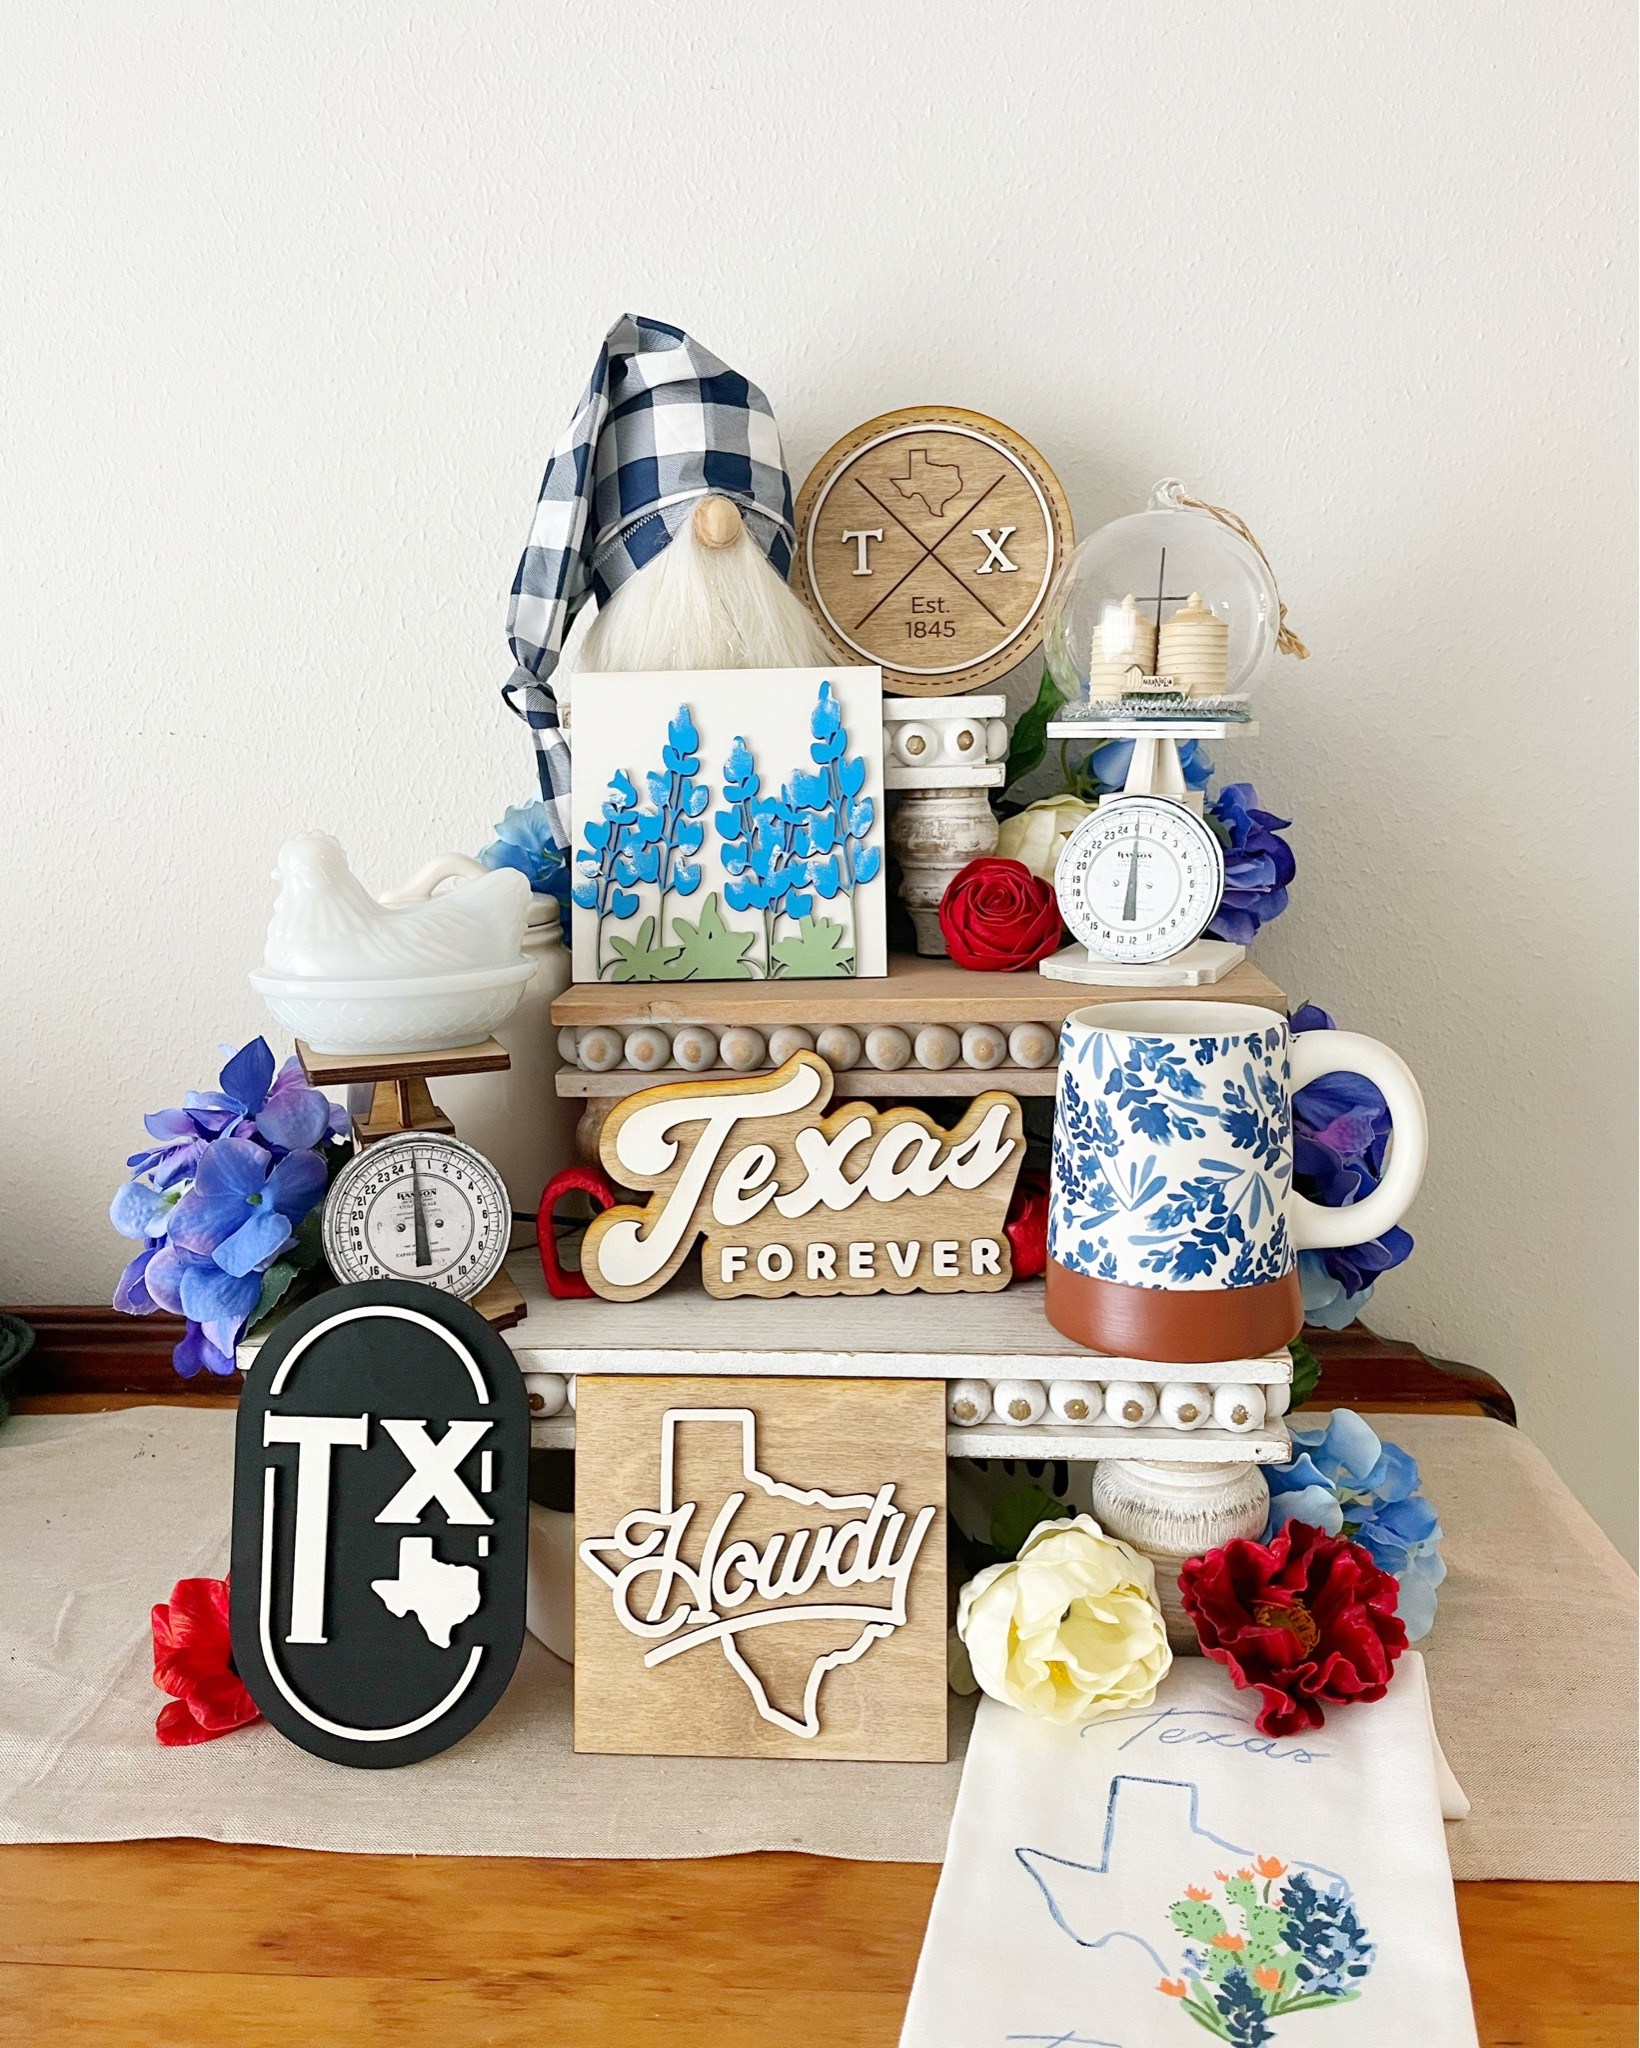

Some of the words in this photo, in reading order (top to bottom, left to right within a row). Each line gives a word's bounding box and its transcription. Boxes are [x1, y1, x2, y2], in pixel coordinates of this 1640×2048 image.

[841, 528, 883, 576] T
[972, 526, 1018, 574] X
[911, 596, 950, 614] Est.
[905, 621, 956, 639] 1845
[1118, 826, 1128, 834] 24
[1104, 831, 1115, 840] 23
[1162, 831, 1167, 840] 2
[1092, 840, 1102, 849] 22
[1173, 840, 1178, 848] 3
[1083, 850, 1091, 858] 21
[1181, 851, 1186, 859] 4
[1076, 862, 1087, 870] 20
[1187, 865, 1192, 874] 5
[1189, 880, 1194, 888] 6
[1076, 901, 1084, 910] 17
[1180, 908, 1185, 916] 8
[1083, 913, 1090, 921] 16
[1090, 922, 1098, 930] 15
[1171, 919, 1175, 927] 9
[1103, 930, 1110, 938] 14
[1158, 927, 1165, 935] 10
[1117, 935, 1124, 943] 13
[392, 1164, 404, 1174] 24
[442, 1164, 448, 1173] 2
[378, 1172, 390, 1183] 23
[456, 1171, 462, 1179] 3
[598, 1063, 1016, 1286] Texas
[365, 1184, 376, 1195] 22
[468, 1181, 474, 1190] 4
[397, 1188, 437, 1200] HANON
[357, 1196, 366, 1206] 21
[477, 1195, 482, 1204] 5
[352, 1210, 363, 1220] 20
[482, 1210, 488, 1219] 6
[351, 1226, 359, 1236] 19
[483, 1226, 488, 1235] 7
[353, 1241, 362, 1251] 18
[479, 1241, 483, 1250] 8
[360, 1255, 368, 1264] 17
[471, 1255, 475, 1264] 9
[721, 1238, 1002, 1283] FOREVER
[370, 1266, 379, 1276] 16
[458, 1265, 466, 1275] 10
[447, 1275, 453, 1284] 11
[262, 1409, 495, 1644] TX
[612, 1482, 936, 1660] Howdy
[1080, 1708, 1329, 1763] Texas
